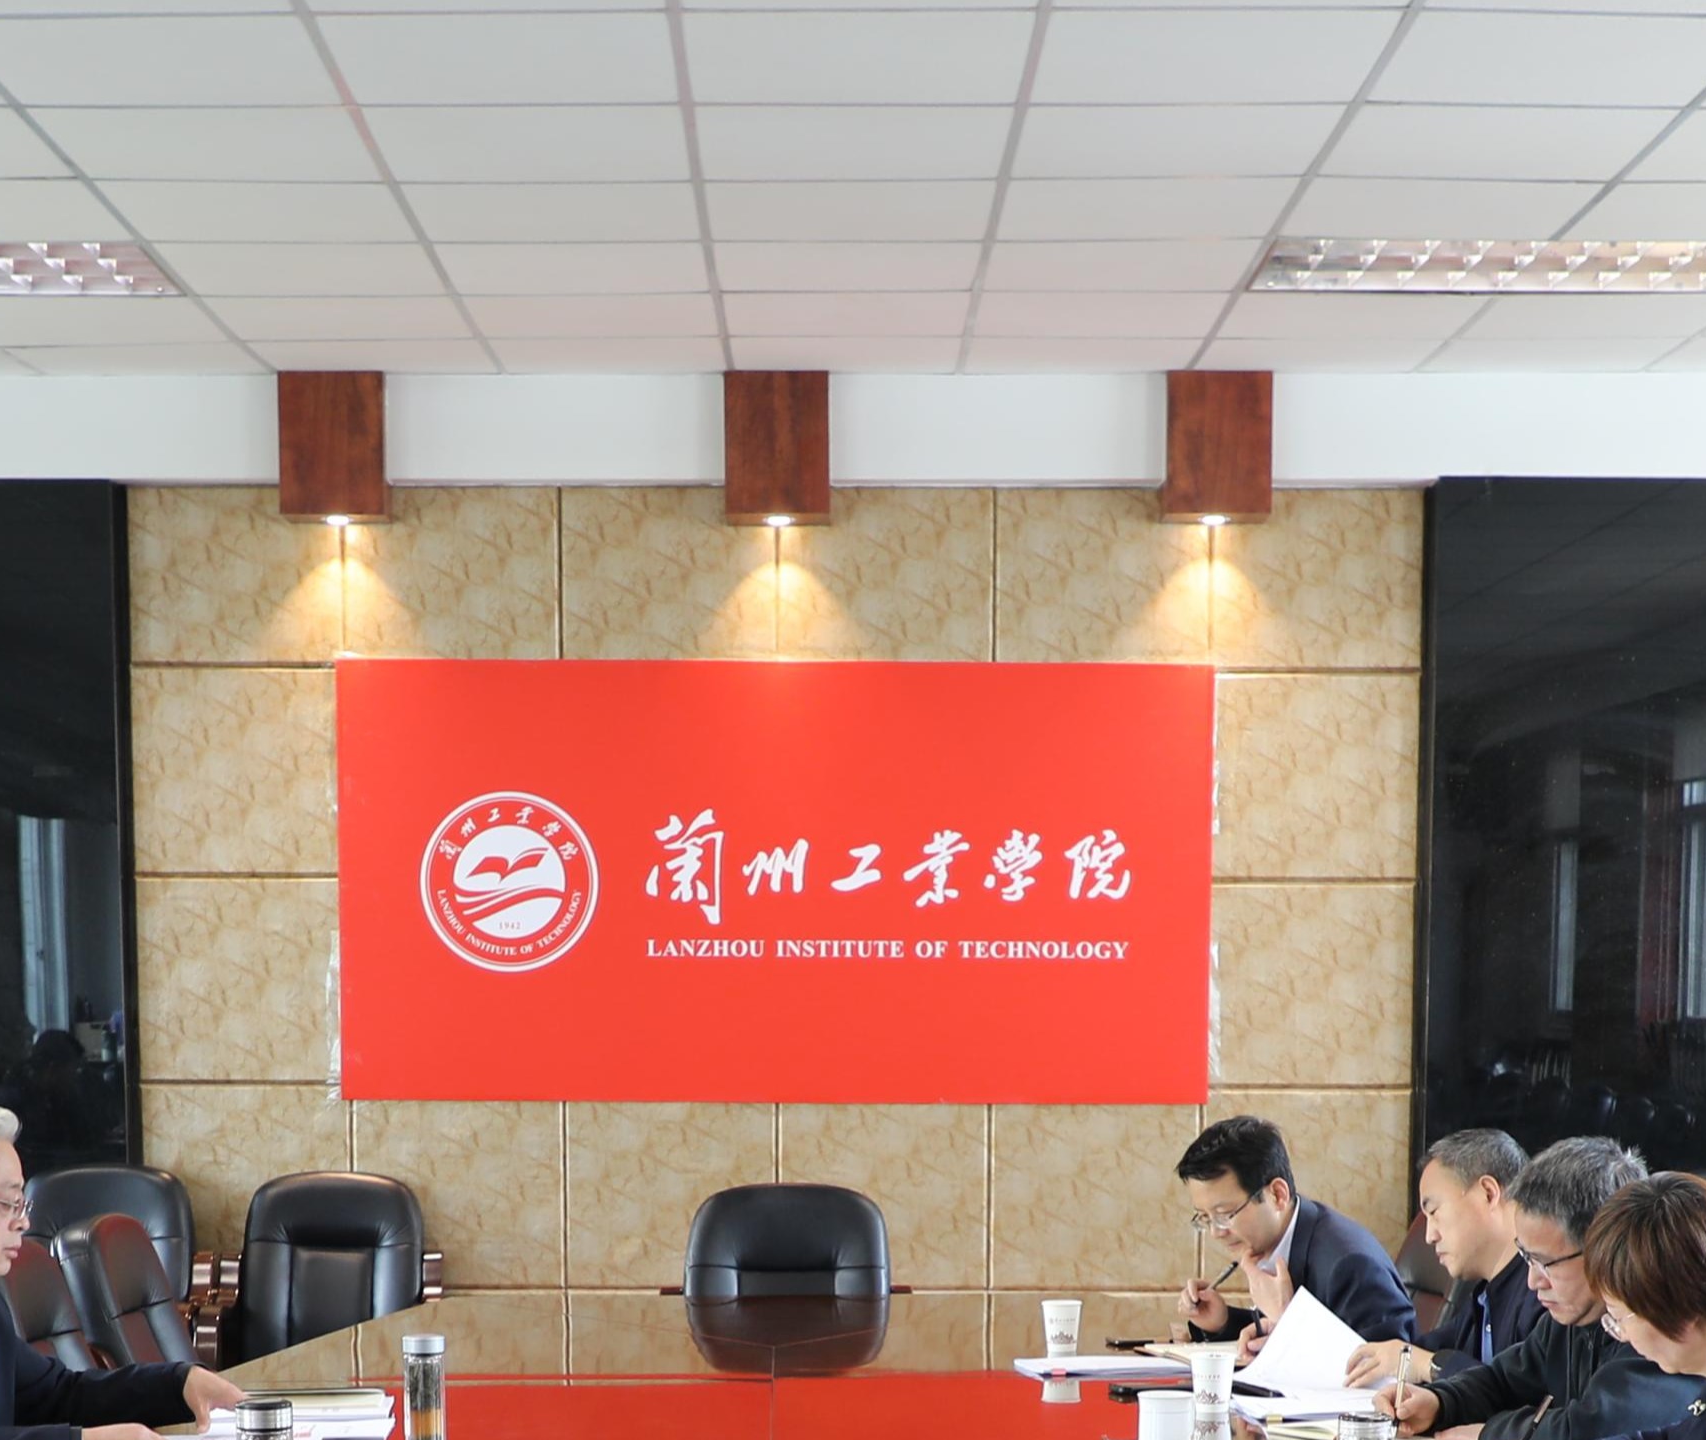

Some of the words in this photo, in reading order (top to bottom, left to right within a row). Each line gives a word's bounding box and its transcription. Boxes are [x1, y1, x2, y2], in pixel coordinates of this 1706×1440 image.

[437, 890, 466, 935] LANZHOU
[465, 933, 518, 956] INSTITUTE
[520, 943, 535, 955] OF
[536, 890, 582, 950] TECHNOLOGY
[647, 939, 764, 960] LANZHOU
[776, 939, 904, 960] INSTITUTE
[915, 939, 948, 960] OF
[958, 939, 1128, 961] TECHNOLOGY
